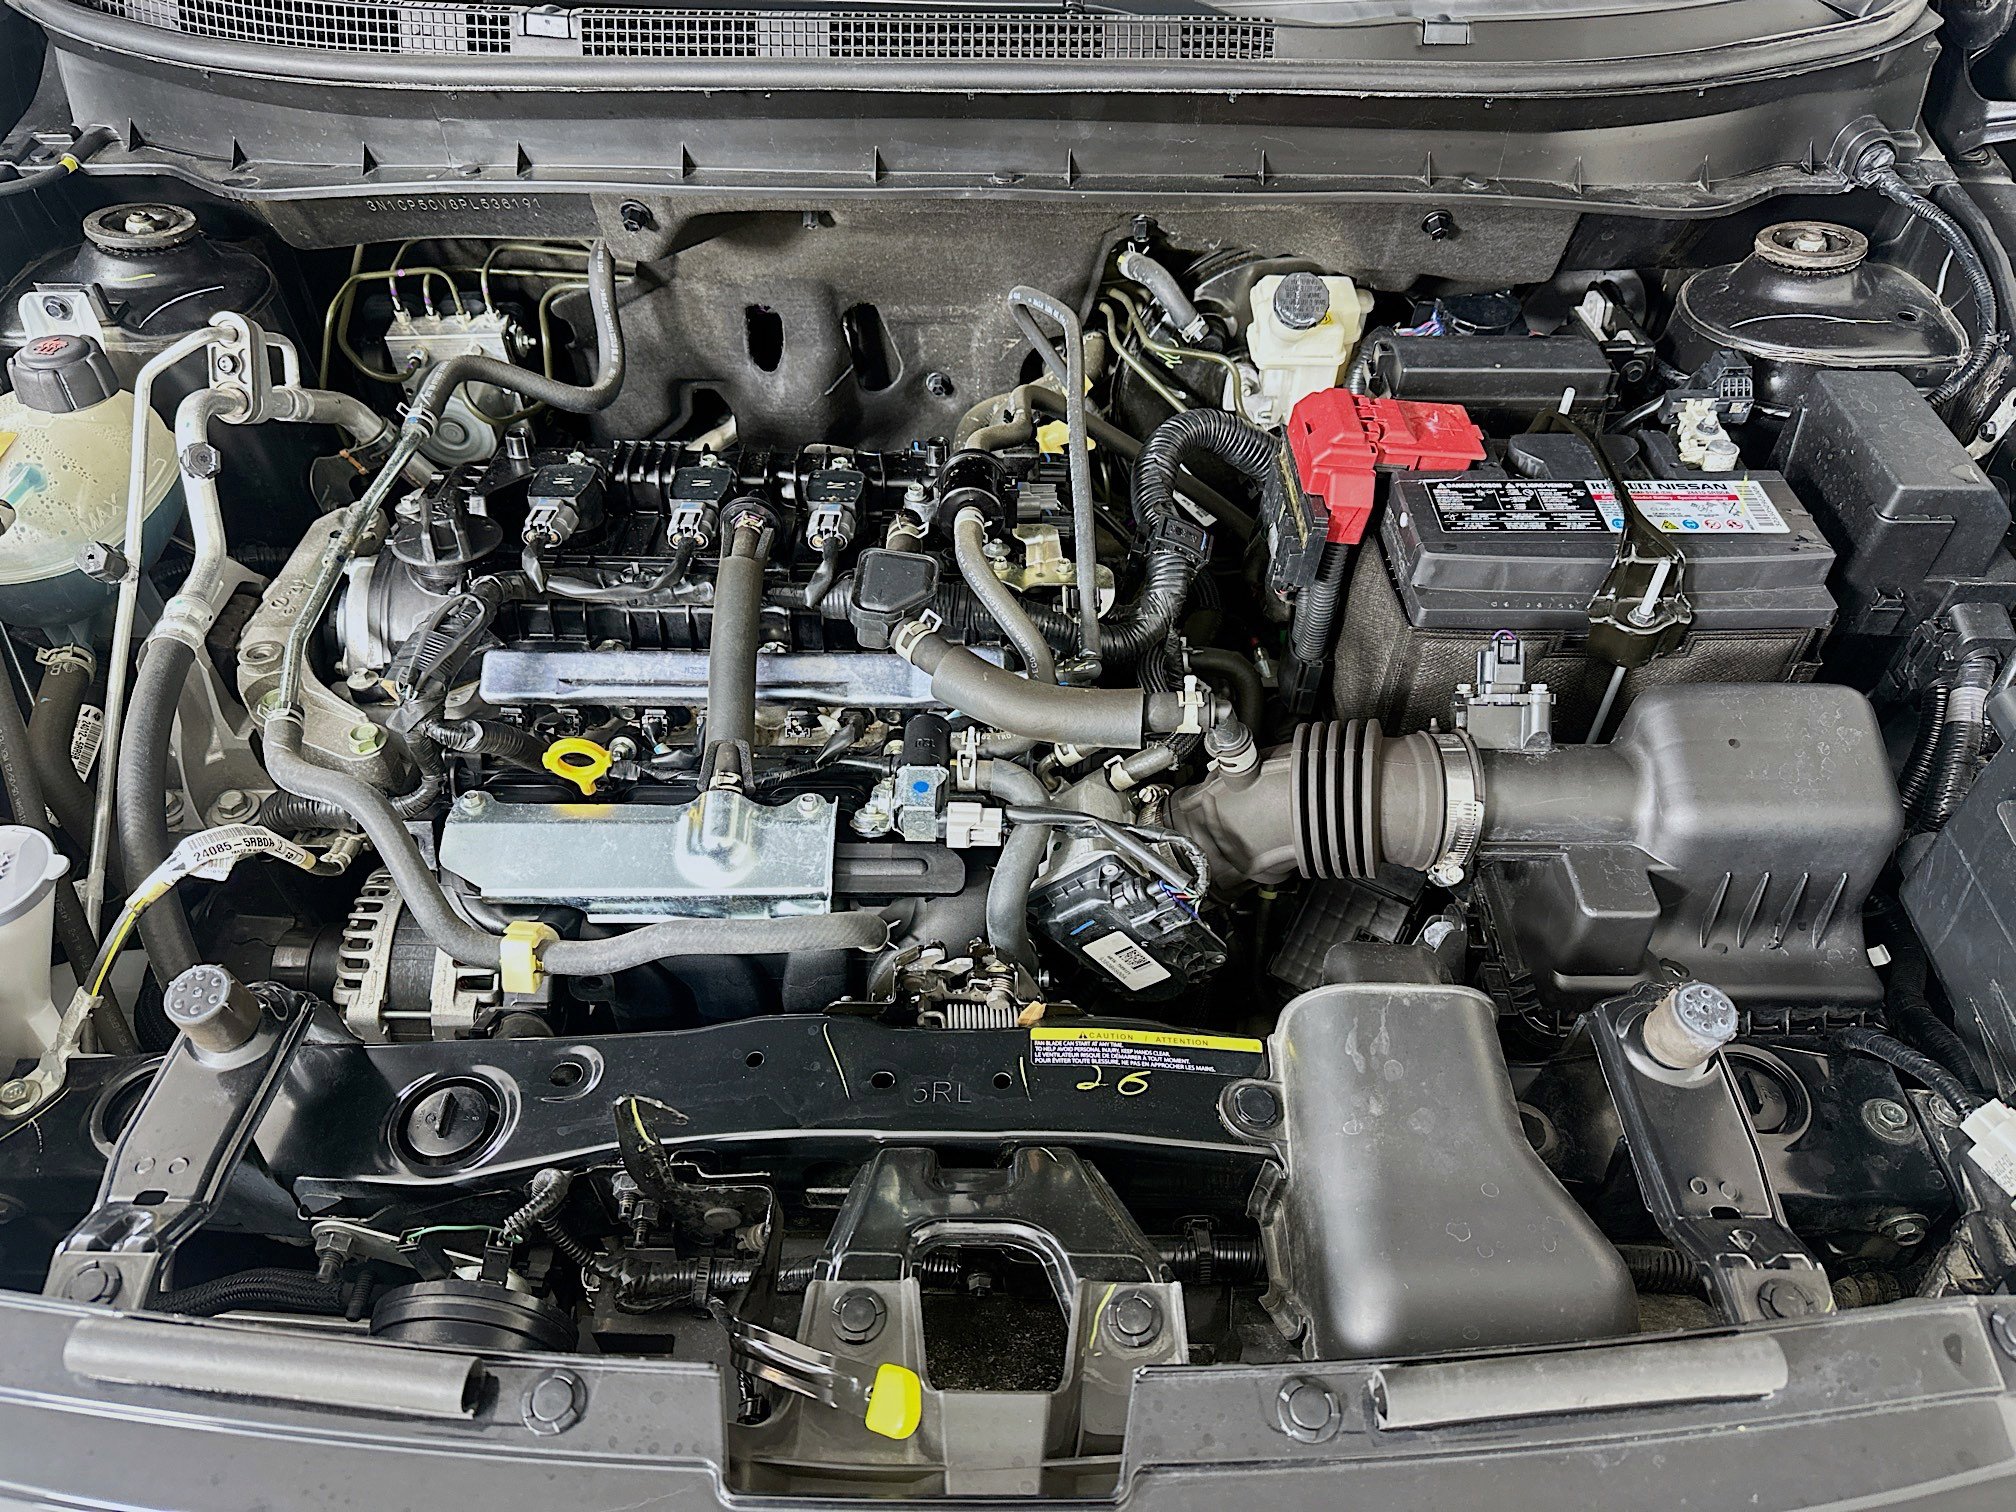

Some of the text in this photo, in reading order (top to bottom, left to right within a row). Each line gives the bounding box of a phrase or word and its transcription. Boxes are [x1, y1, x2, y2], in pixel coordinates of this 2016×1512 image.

[80, 493, 121, 536] MAX
[1155, 1036, 1208, 1046] ATTENTION
[1110, 1053, 1142, 1061] DÉMARRER
[1150, 1062, 1185, 1070] APPROCHER
